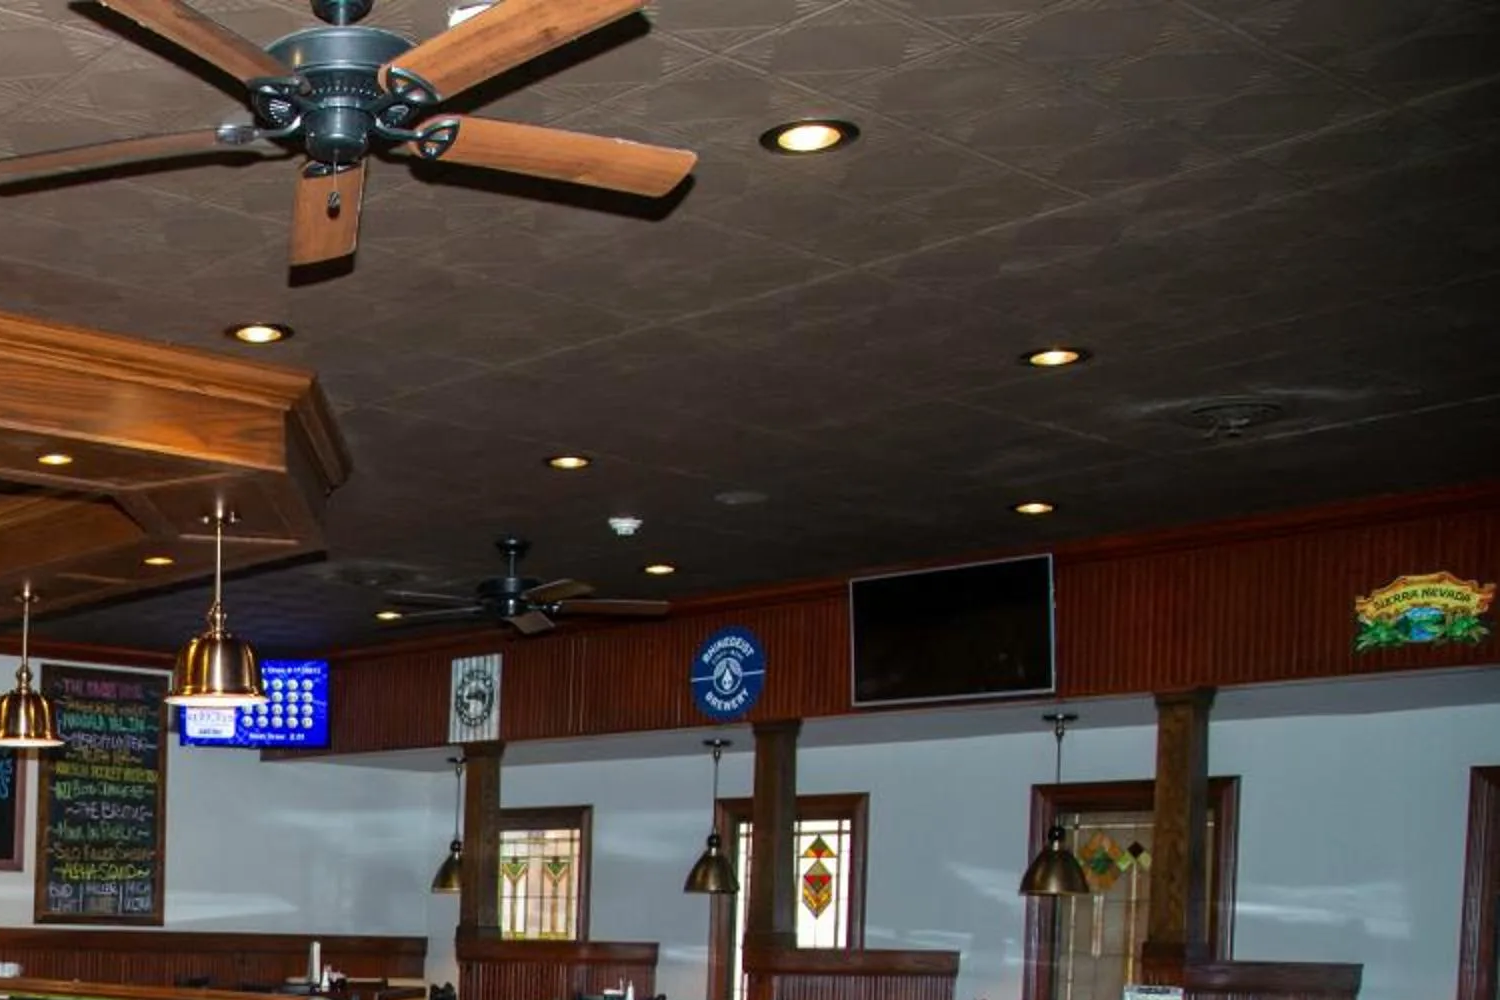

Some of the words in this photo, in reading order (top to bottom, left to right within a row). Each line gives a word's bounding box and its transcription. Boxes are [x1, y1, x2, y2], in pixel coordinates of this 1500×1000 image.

[1374, 590, 1418, 609] SIERRA
[1421, 588, 1471, 602] NEVADA
[702, 636, 754, 664] RHINEGEIST
[705, 688, 748, 711] BREWERY
